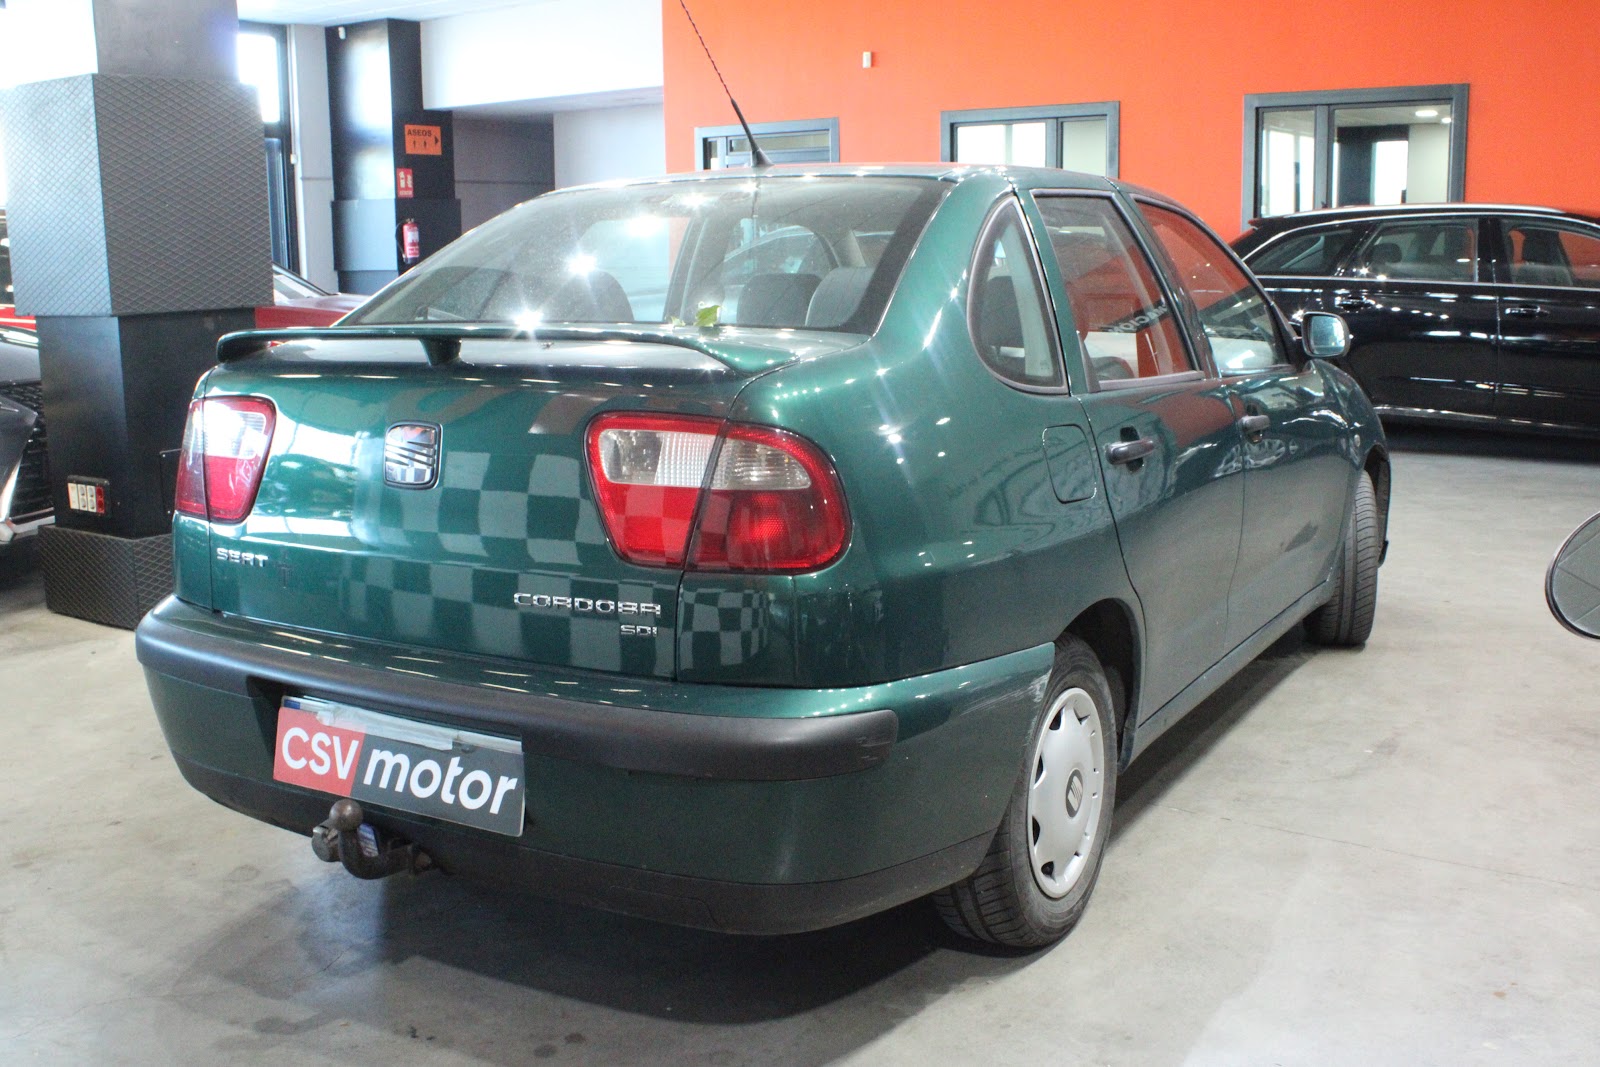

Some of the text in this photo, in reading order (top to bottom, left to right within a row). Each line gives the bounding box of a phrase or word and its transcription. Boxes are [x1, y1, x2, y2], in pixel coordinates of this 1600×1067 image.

[407, 129, 432, 137] ASEOS
[217, 547, 269, 567] SEAT
[513, 592, 661, 616] CORDOBA
[620, 624, 658, 637] SDI
[282, 727, 518, 815] CSV motor
